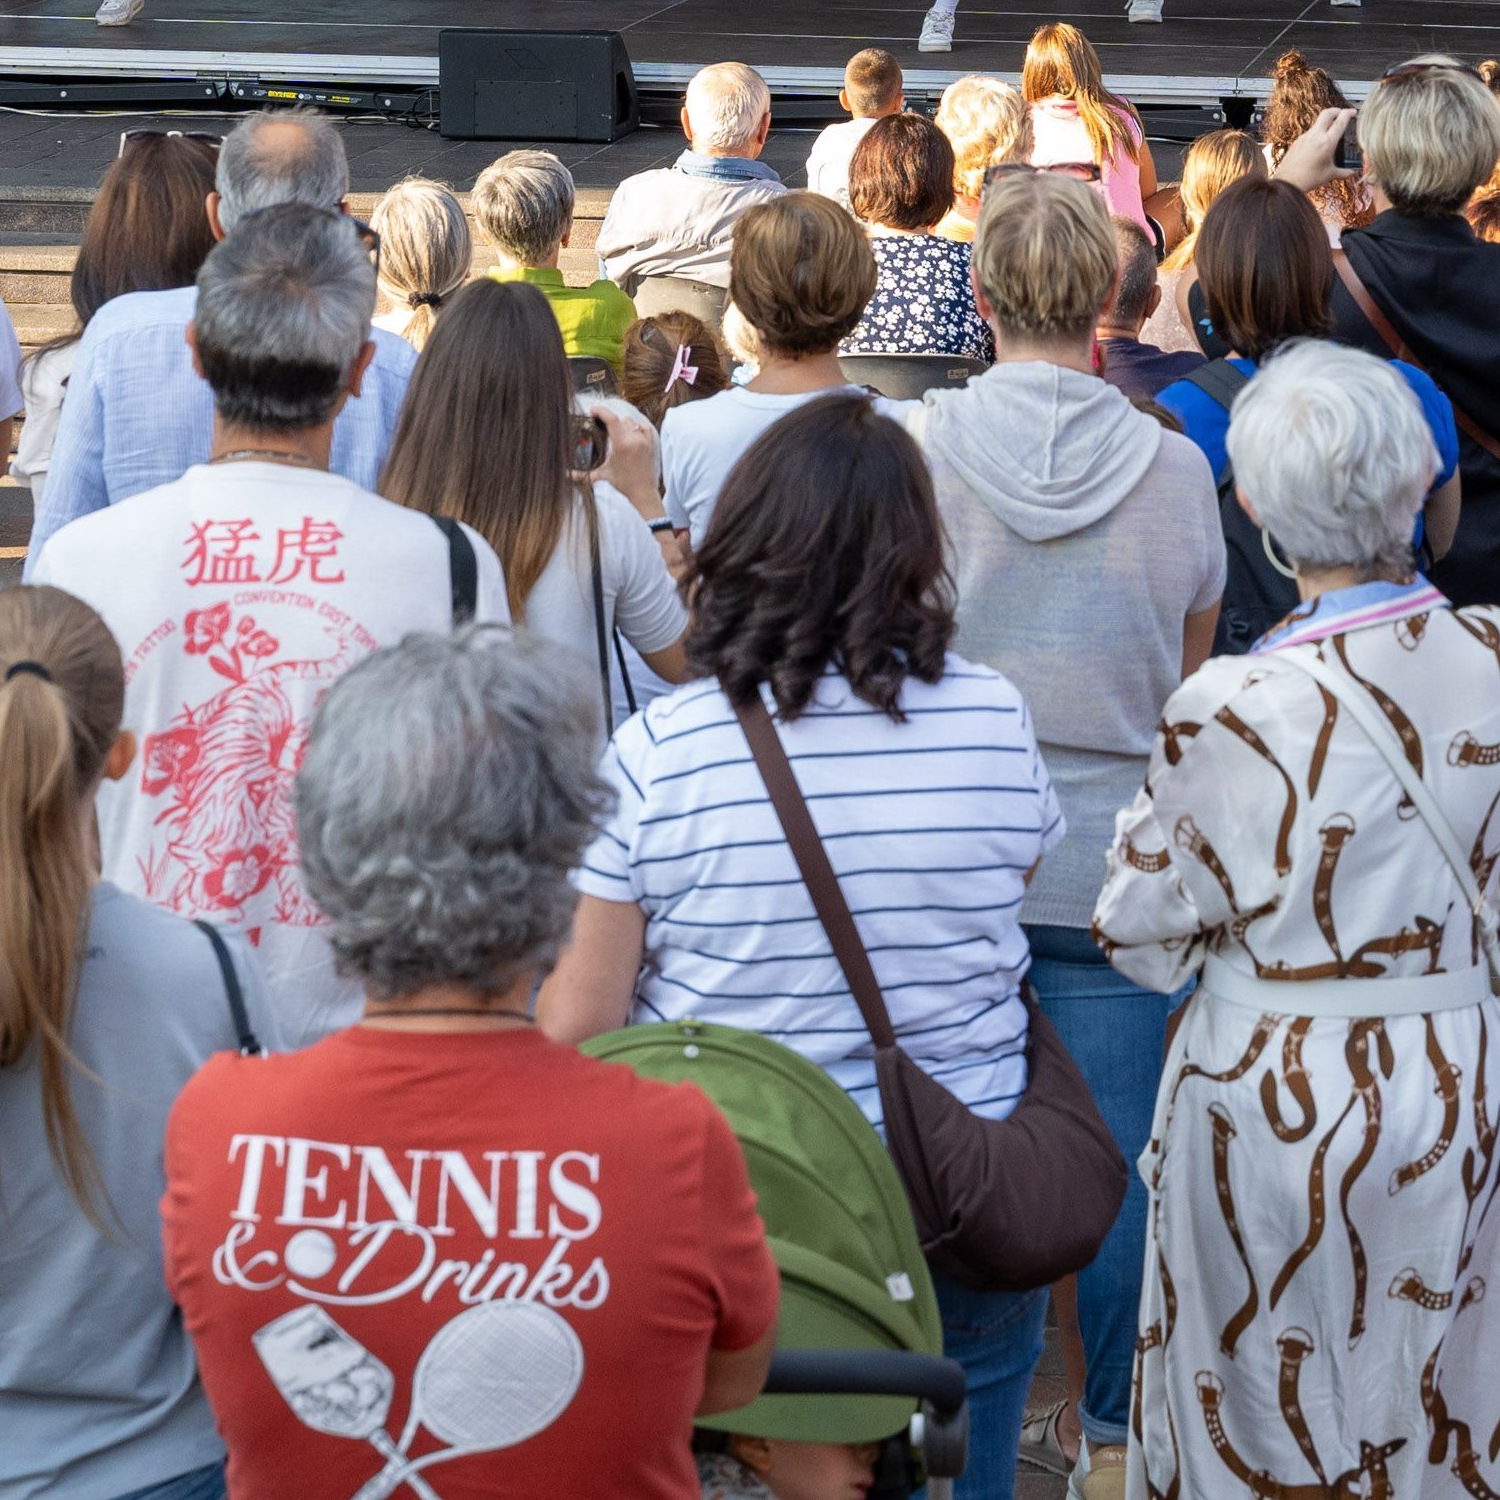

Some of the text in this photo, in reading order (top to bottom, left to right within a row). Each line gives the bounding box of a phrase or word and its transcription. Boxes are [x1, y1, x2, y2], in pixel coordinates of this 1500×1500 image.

[181, 516, 346, 587] 猛虎
[234, 591, 315, 608] CONVENTION
[227, 1133, 602, 1241] TENNIS
[212, 1219, 610, 1310] & Drinks
